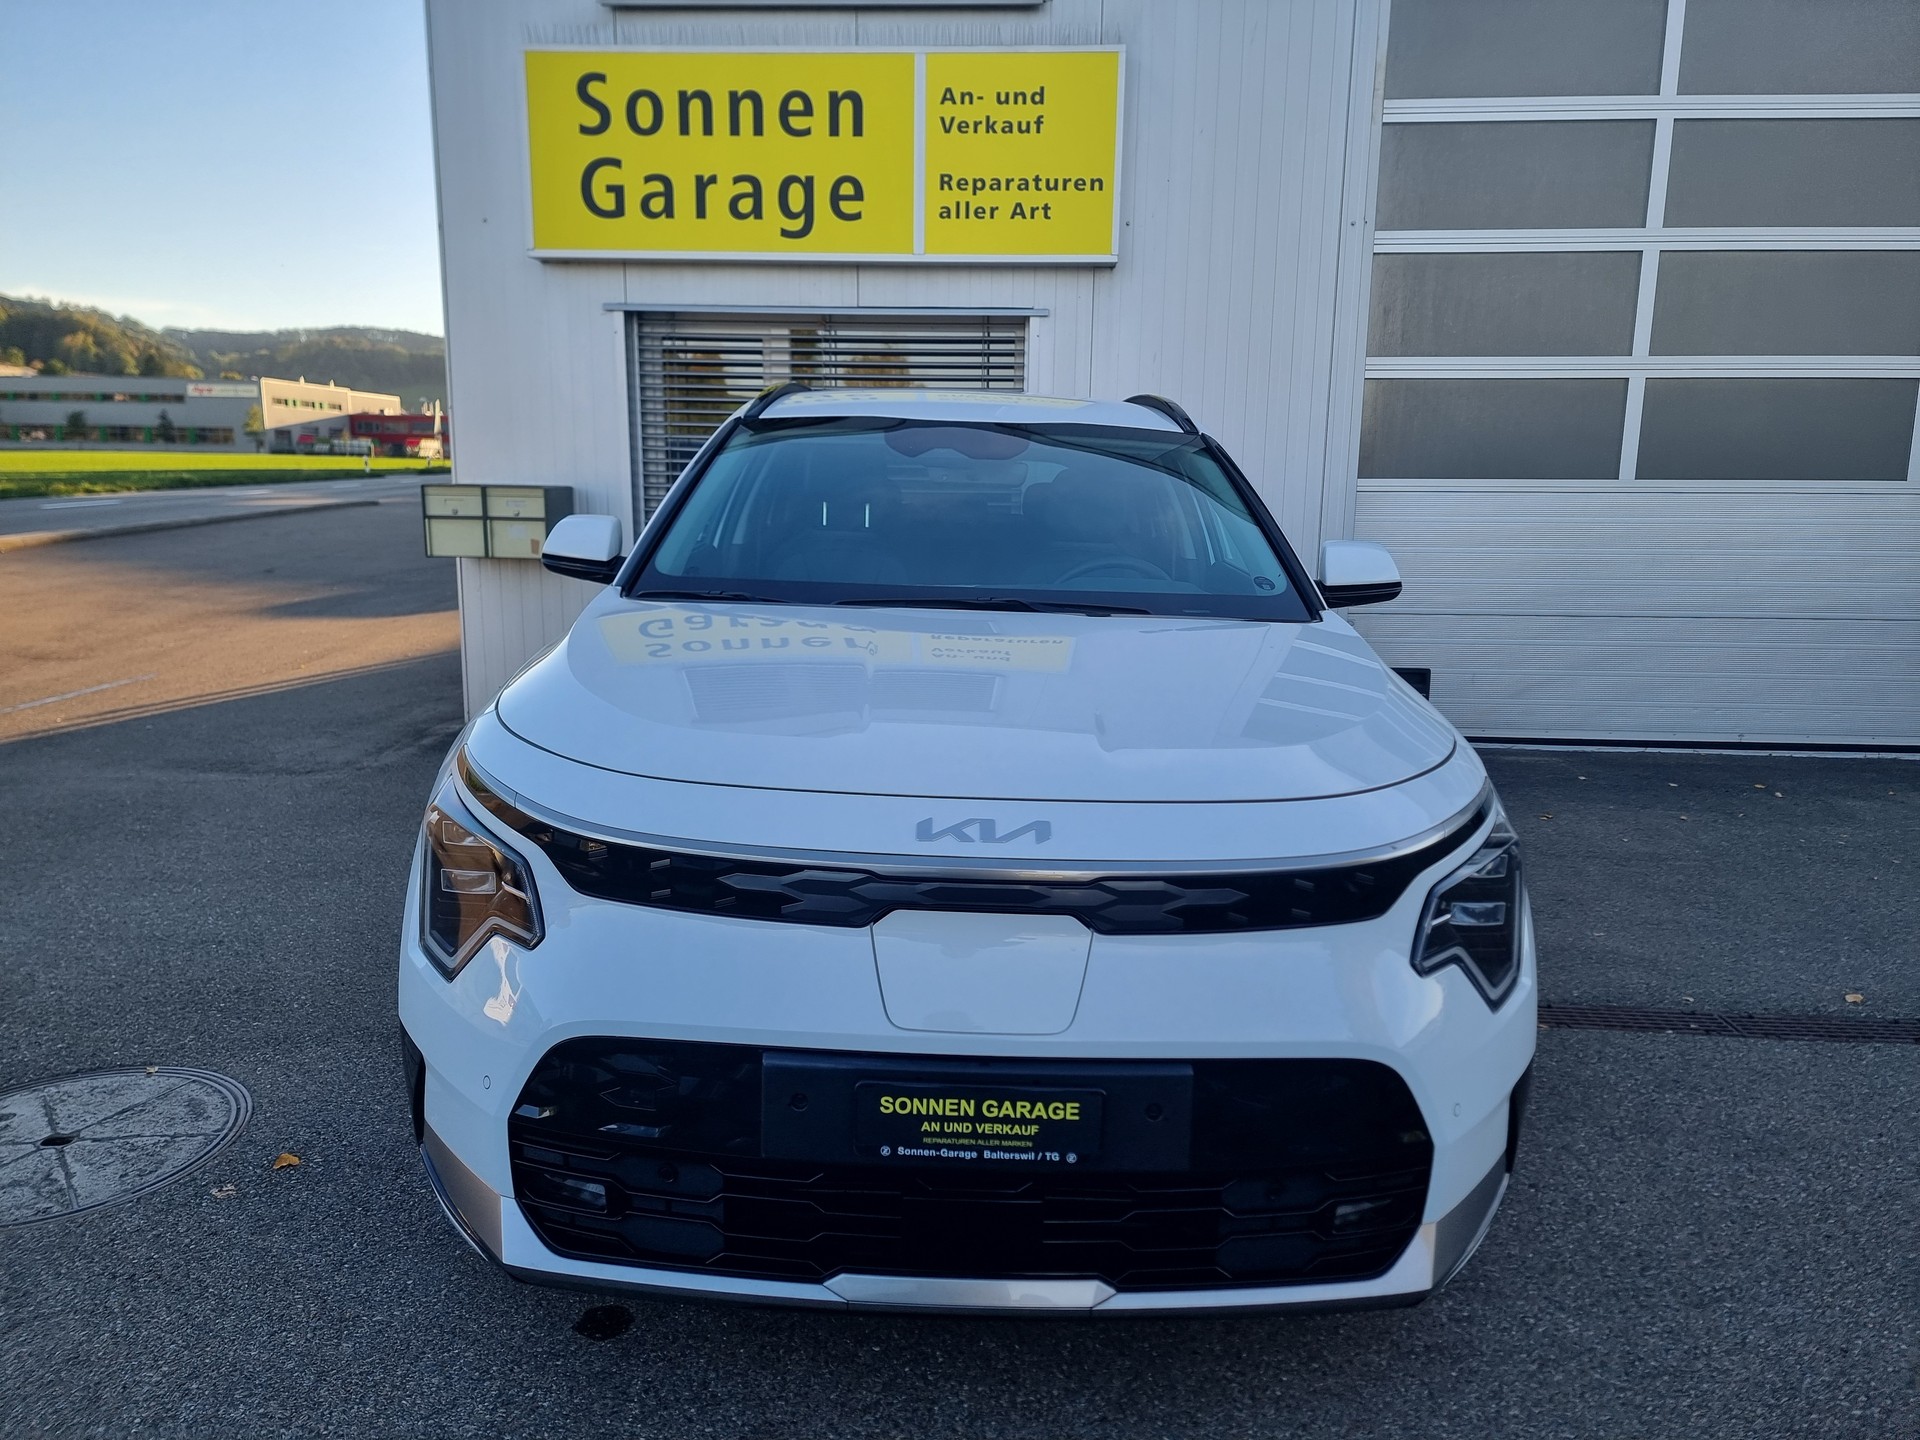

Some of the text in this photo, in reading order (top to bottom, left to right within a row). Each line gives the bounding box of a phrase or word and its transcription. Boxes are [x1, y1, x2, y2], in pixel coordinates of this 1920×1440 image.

[576, 71, 864, 138] Sonnen
[939, 86, 1045, 105] An- und
[939, 115, 1044, 134] Verkauf
[939, 173, 1105, 196] Reparaturen
[580, 157, 865, 239] Garage
[938, 201, 1052, 219] aller Art
[915, 817, 1052, 845] KIA
[879, 1096, 1081, 1121] SONNEN GARAGE
[921, 1121, 1040, 1136] AN UND VERKAUF
[922, 1137, 1033, 1148] REPARATUREN ALLER MARKEN
[897, 1146, 978, 1160] Sonnen-Garage
[983, 1149, 1035, 1161] Balterswil
[1046, 1152, 1060, 1162] TG
